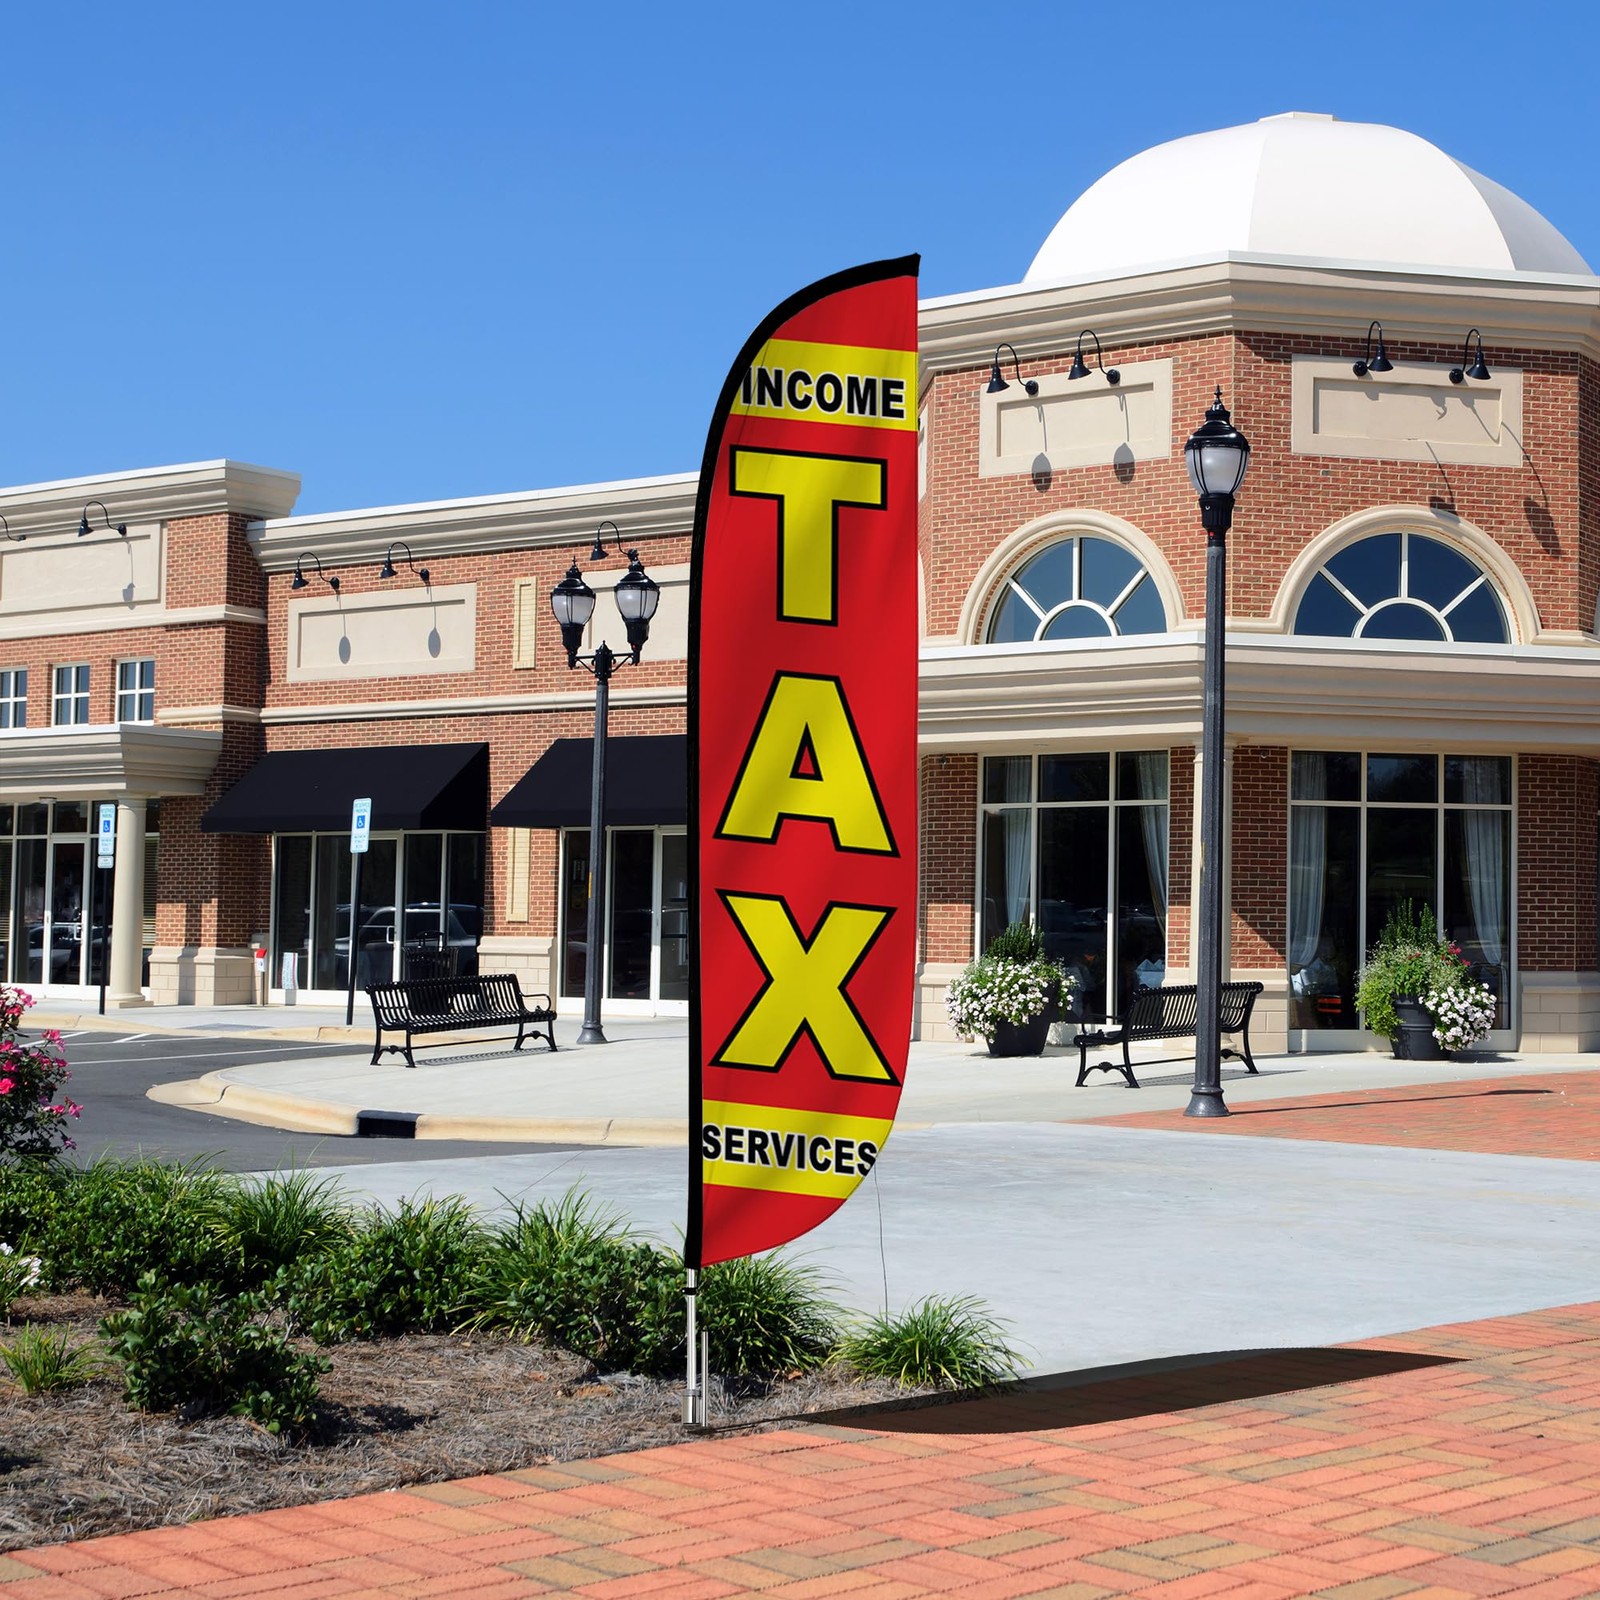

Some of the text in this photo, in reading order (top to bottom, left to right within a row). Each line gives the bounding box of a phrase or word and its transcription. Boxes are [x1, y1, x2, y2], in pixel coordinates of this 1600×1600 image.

[741, 366, 905, 419] INCOME
[707, 444, 902, 1087] TAX
[702, 1124, 878, 1177] SERVICES
